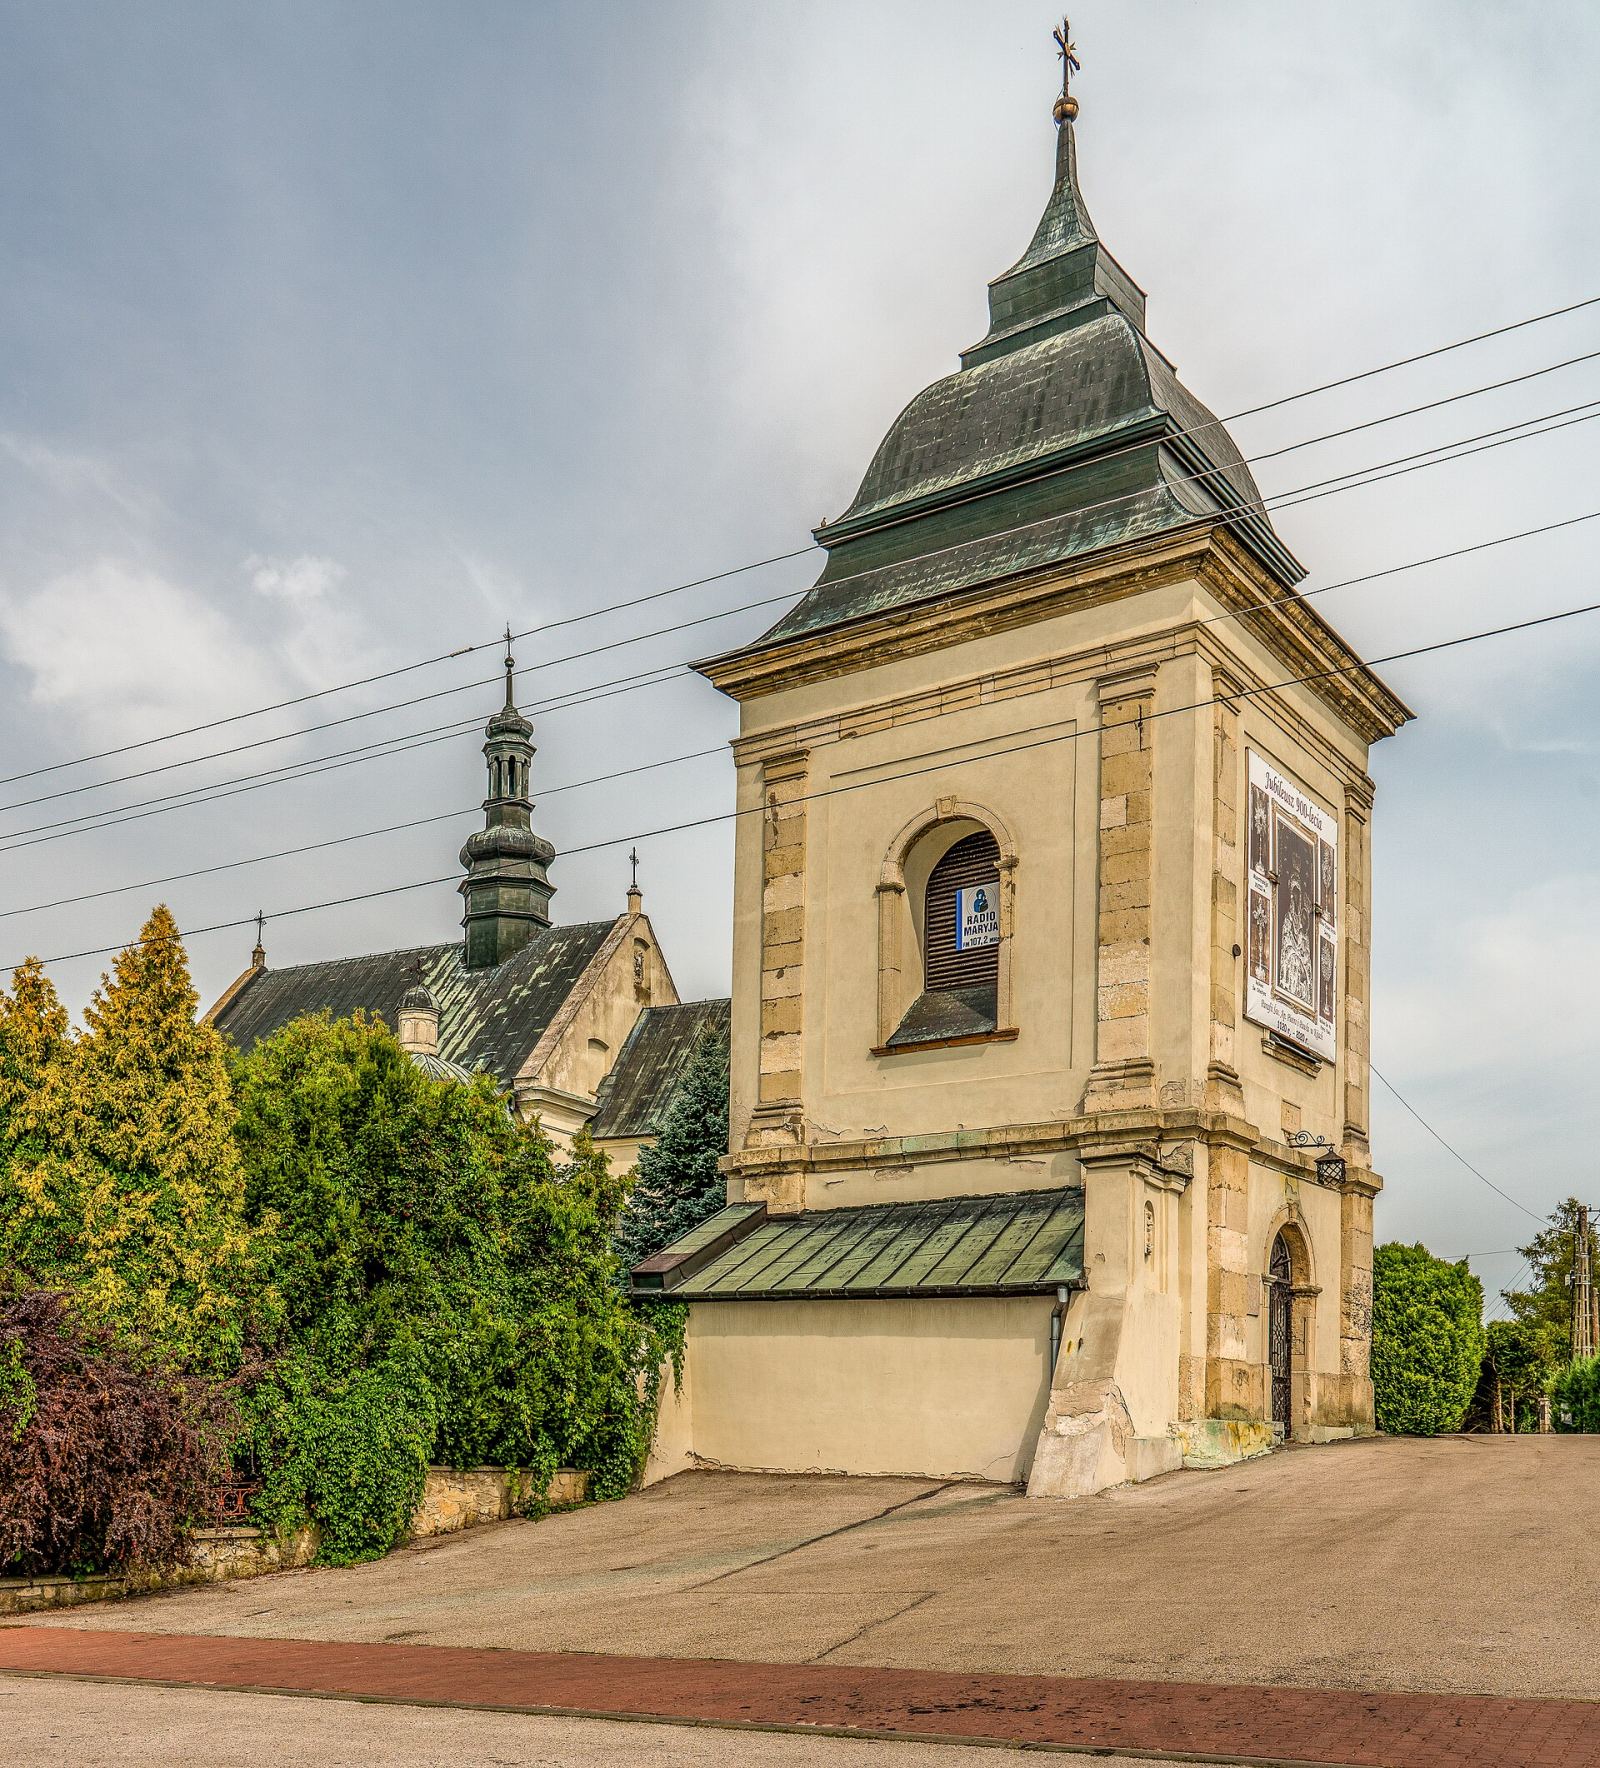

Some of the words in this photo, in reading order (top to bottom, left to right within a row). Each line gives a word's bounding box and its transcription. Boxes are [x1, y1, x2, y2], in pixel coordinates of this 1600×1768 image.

[1265, 772, 1294, 808] Jubileusz
[1296, 797, 1322, 831] 900-lecia
[967, 911, 995, 925] RADIO
[964, 922, 998, 936] MARYJA
